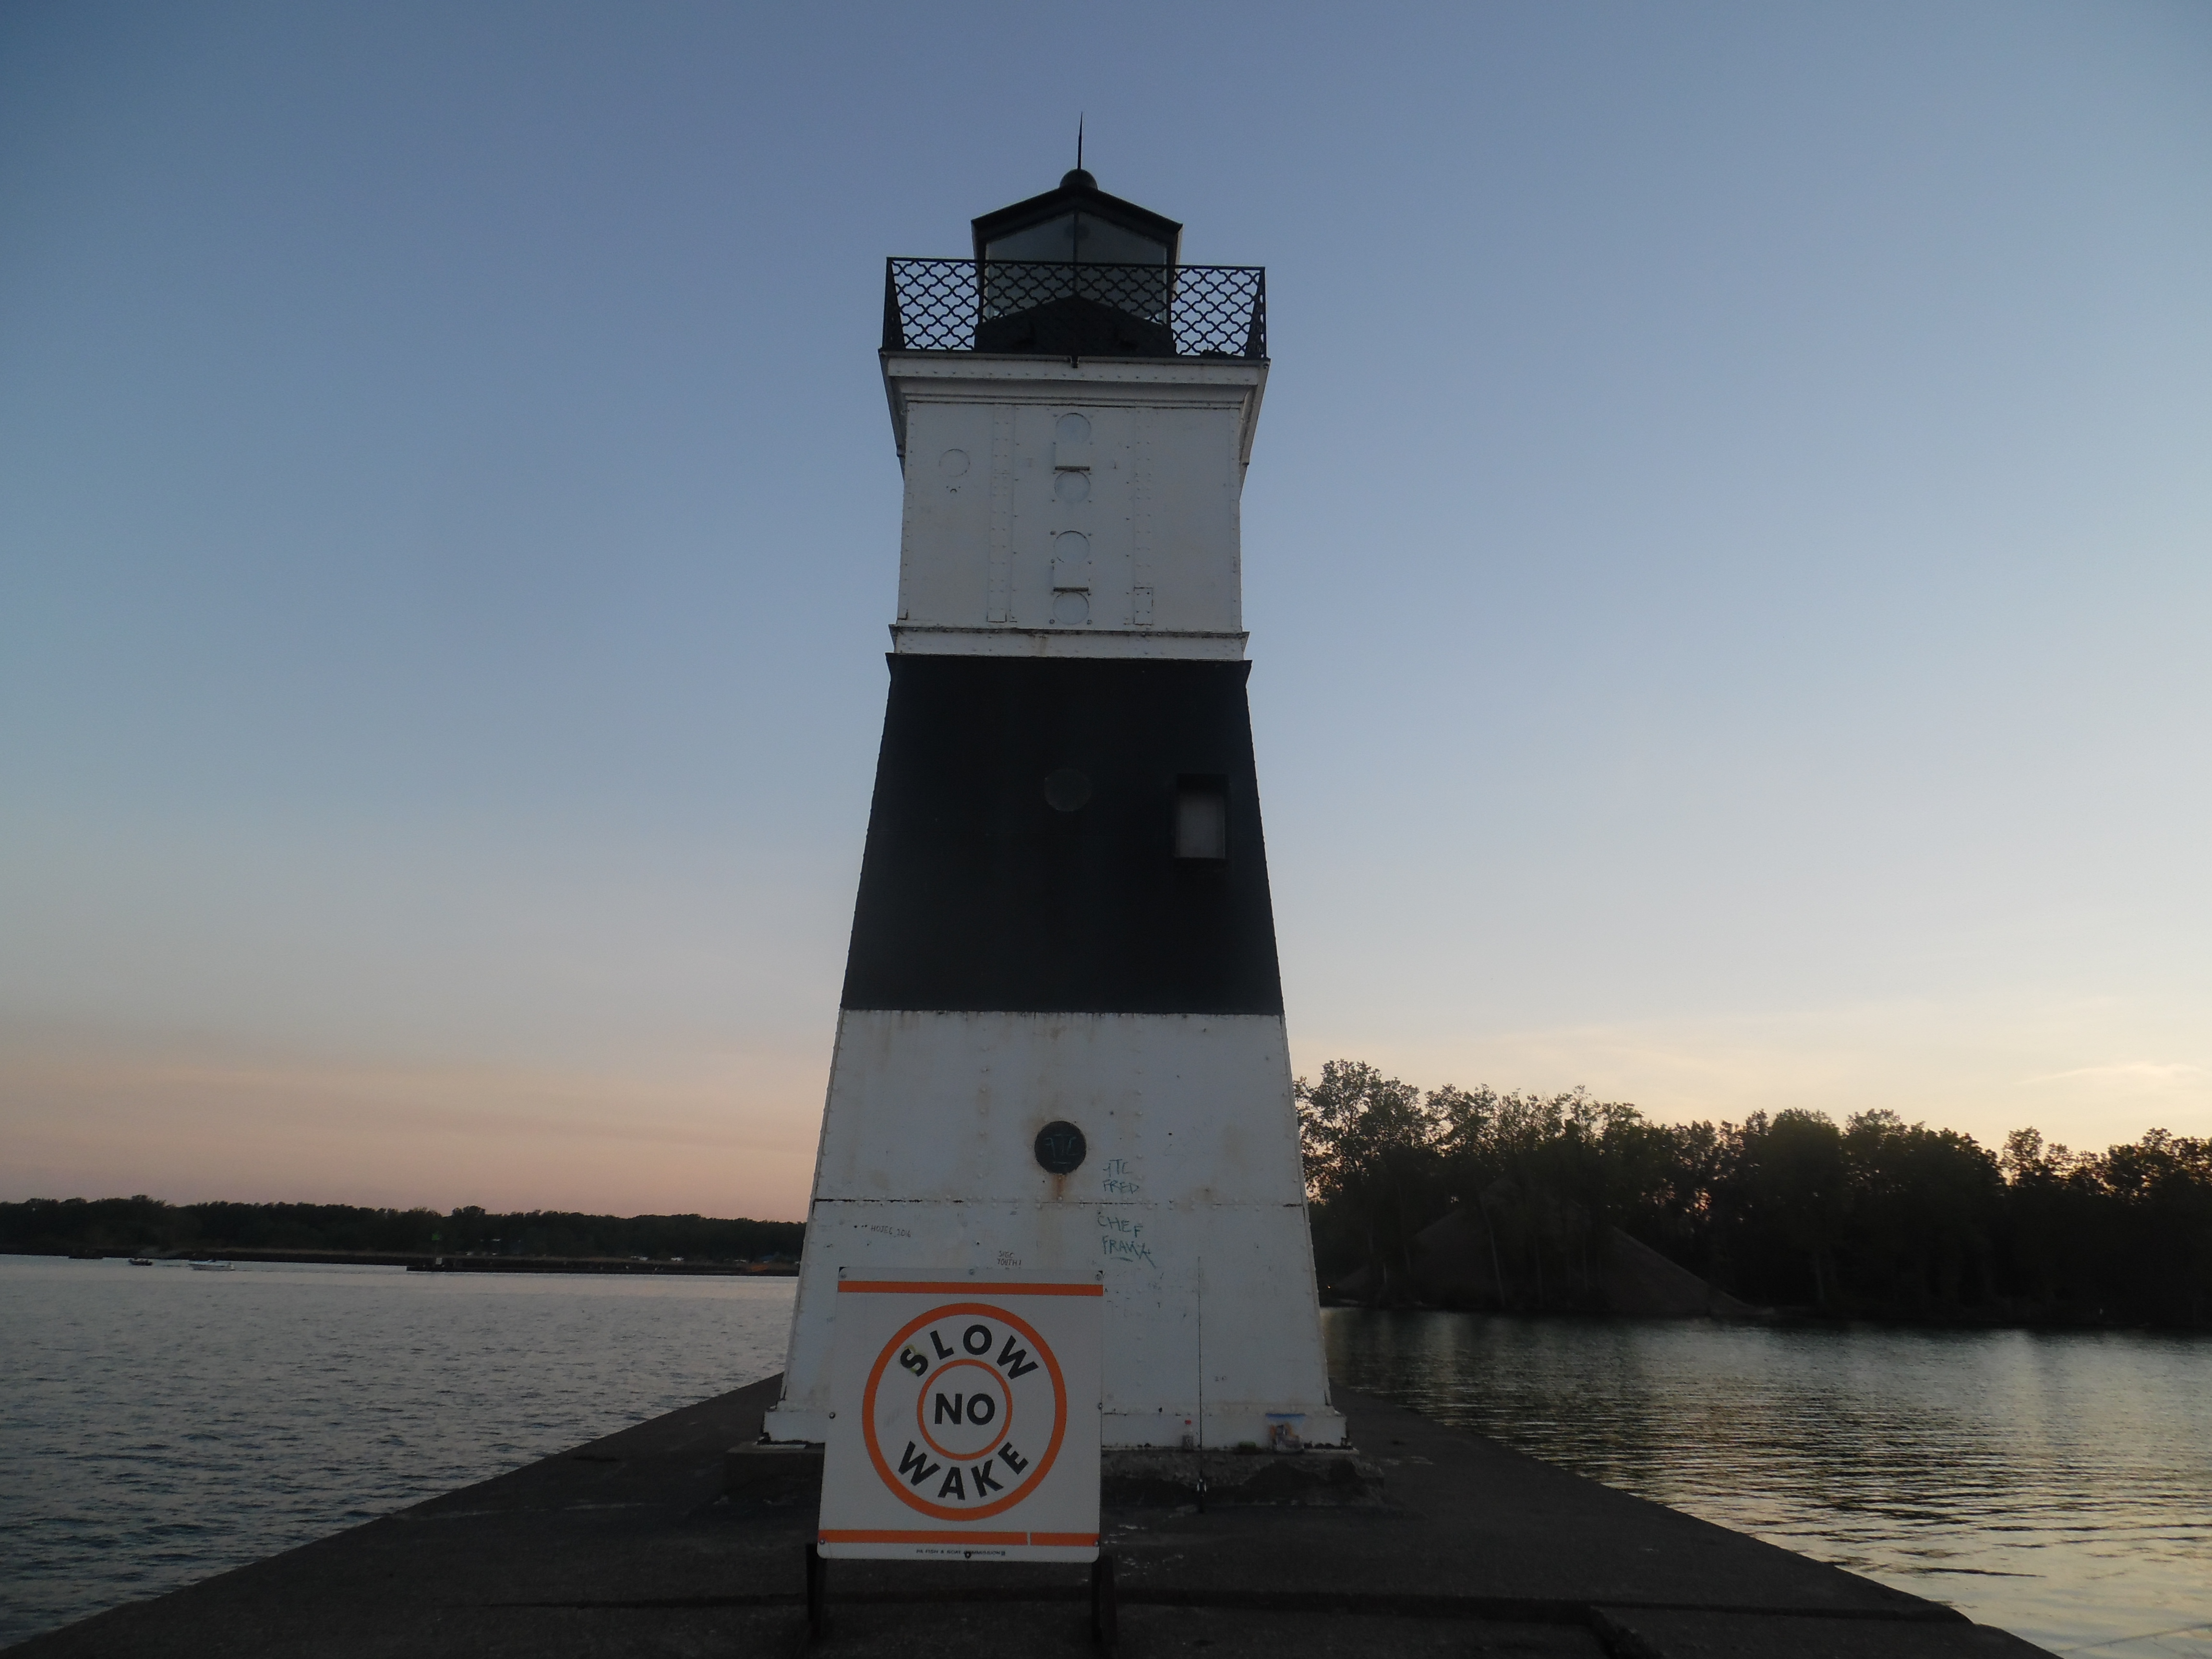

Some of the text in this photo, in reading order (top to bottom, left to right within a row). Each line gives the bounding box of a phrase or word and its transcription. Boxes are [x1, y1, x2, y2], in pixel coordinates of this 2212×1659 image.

[1102, 1178, 1139, 1194] FRED
[1097, 1215, 1143, 1238] CHEF
[900, 1324, 1039, 1379] SLOW
[934, 1393, 995, 1425] NO
[898, 1441, 1029, 1501] WAKE
